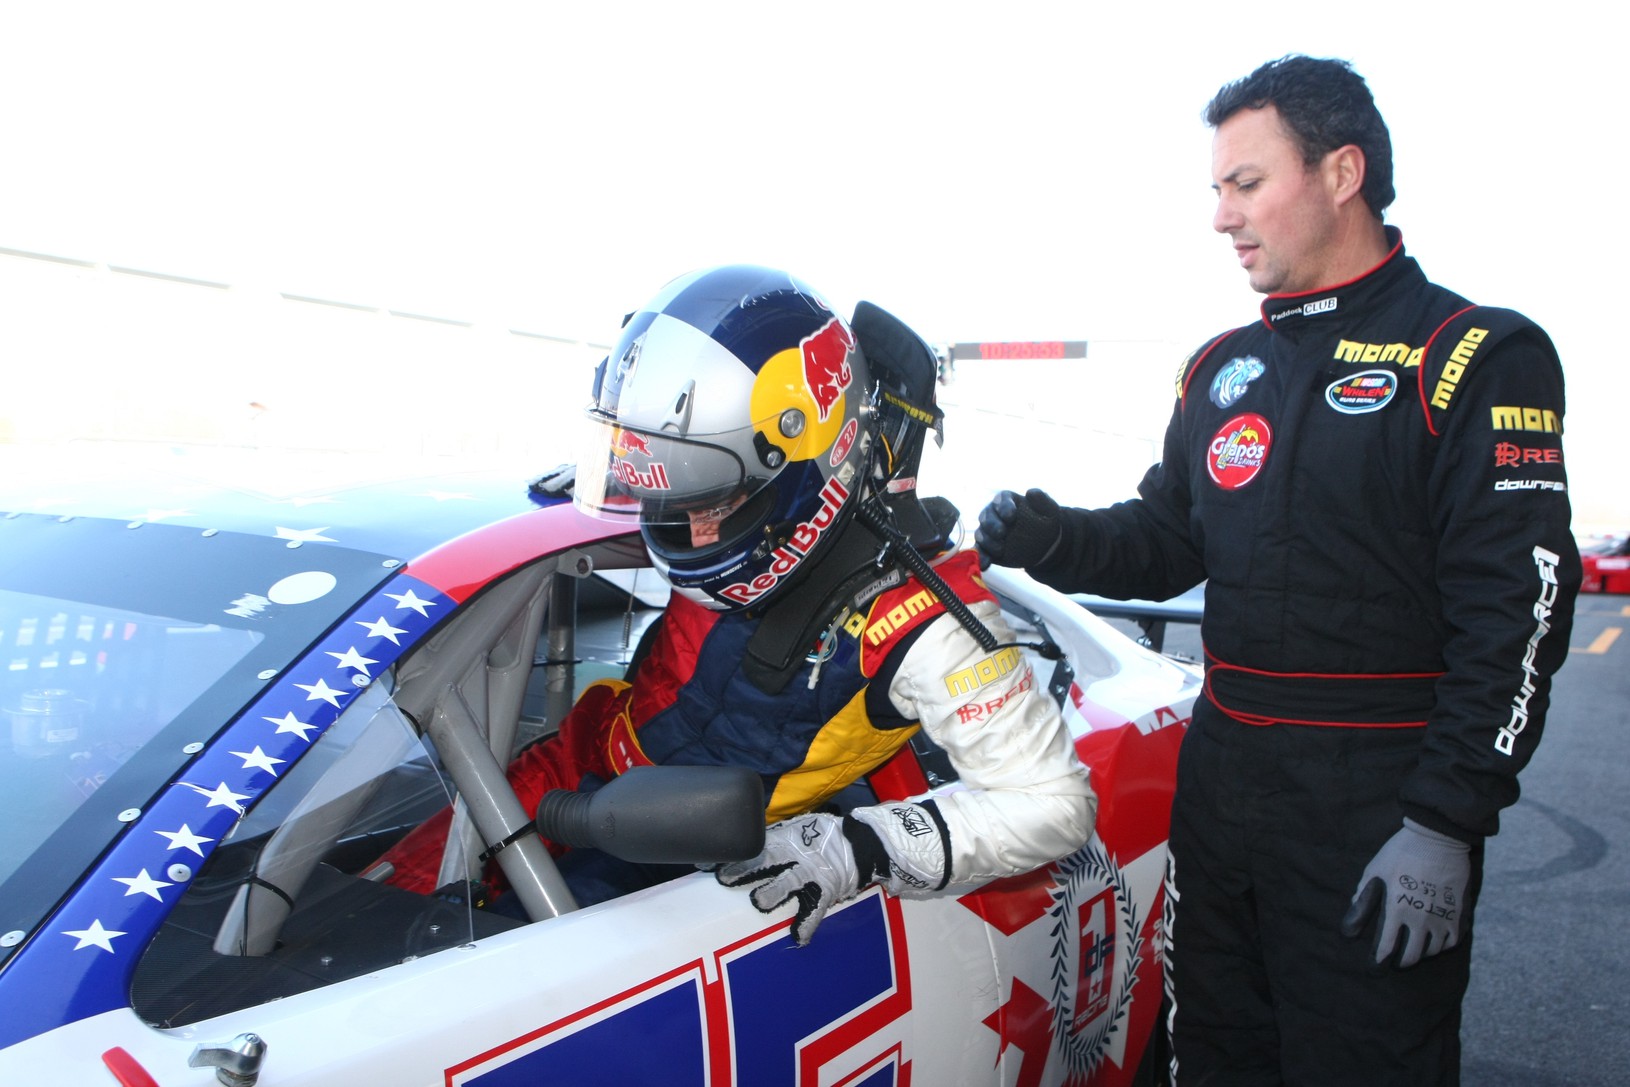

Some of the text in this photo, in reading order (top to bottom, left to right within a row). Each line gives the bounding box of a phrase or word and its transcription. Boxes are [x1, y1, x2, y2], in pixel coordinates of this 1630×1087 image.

[1271, 298, 1336, 321] Paddock CLUB
[621, 462, 672, 490] Bull
[717, 474, 850, 606] Red Bull
